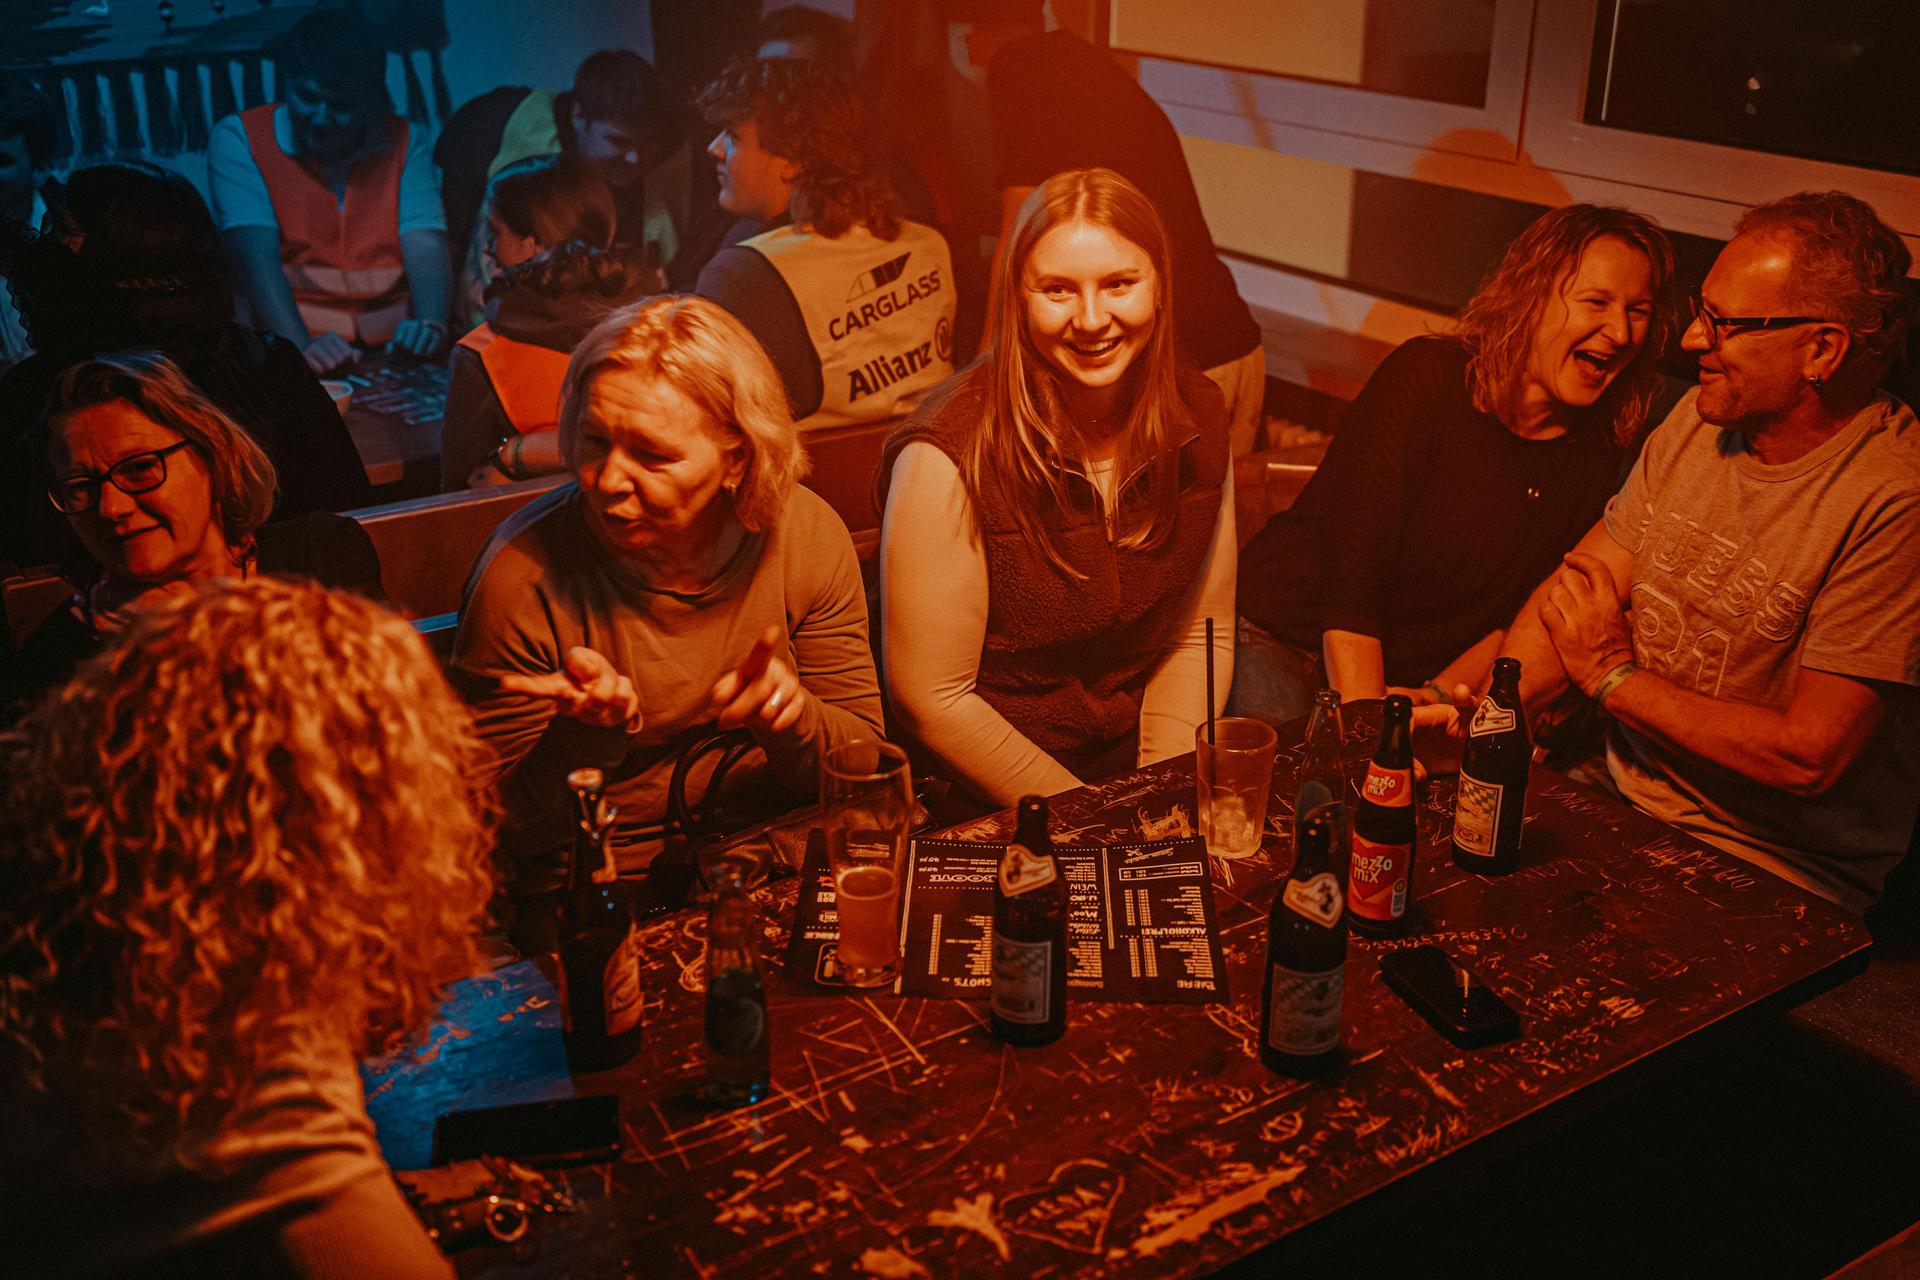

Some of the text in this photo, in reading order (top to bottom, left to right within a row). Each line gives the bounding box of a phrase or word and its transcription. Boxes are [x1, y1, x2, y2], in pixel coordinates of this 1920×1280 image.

[829, 270, 941, 341] CARGLASS
[848, 341, 932, 402] Allianz
[1368, 774, 1395, 788] mezzo
[1352, 852, 1392, 871] mezzo
[1354, 867, 1382, 884] mix
[1069, 883, 1097, 891] WEIN
[954, 977, 992, 988] SHOTS
[1177, 980, 1217, 991] BIERE
